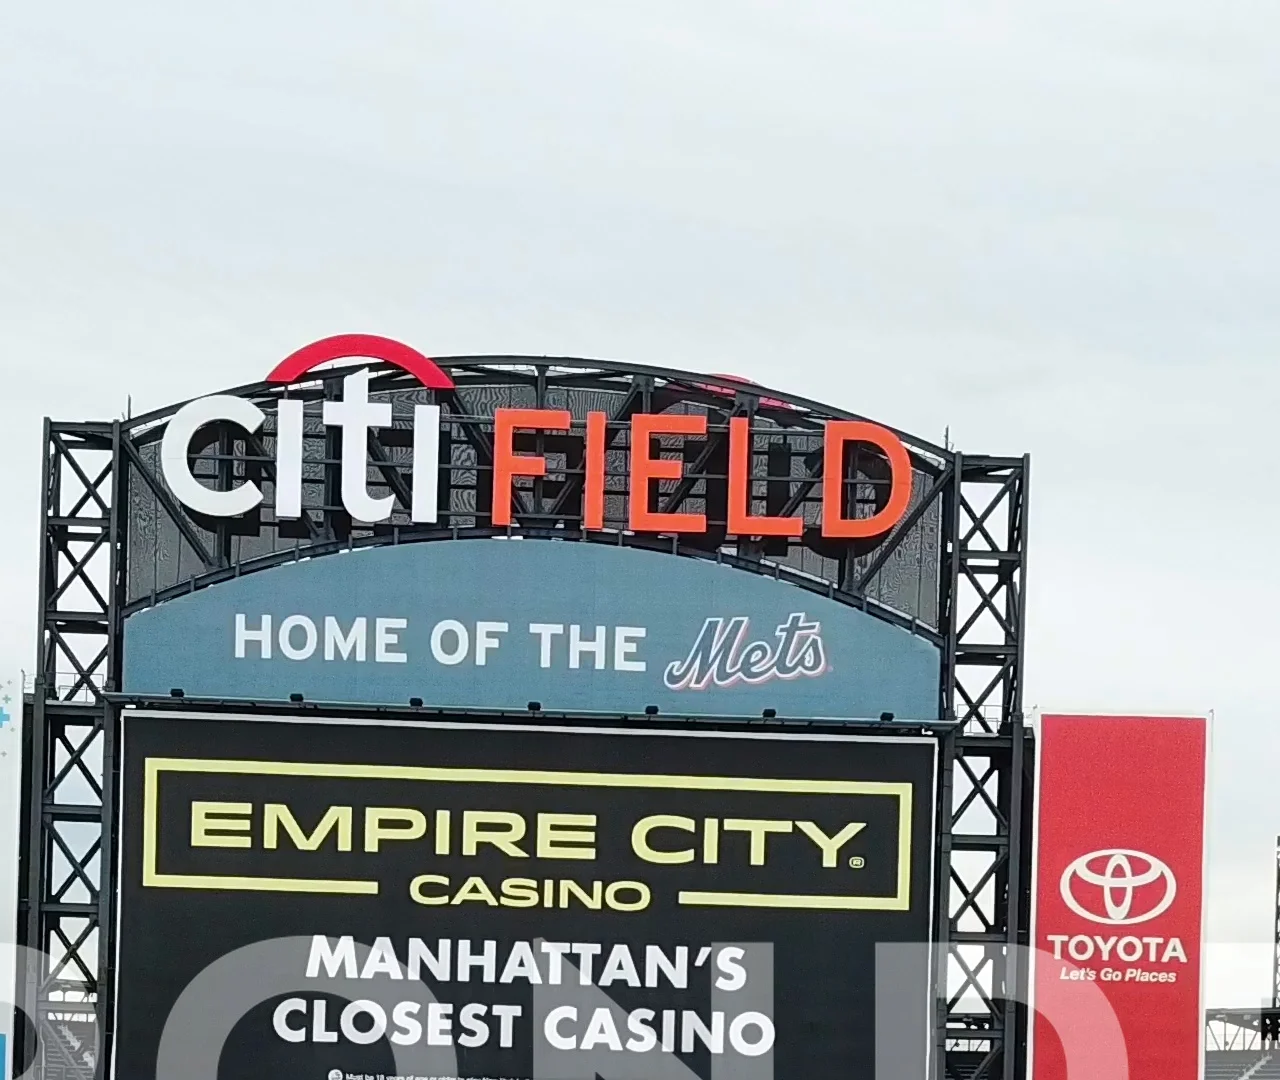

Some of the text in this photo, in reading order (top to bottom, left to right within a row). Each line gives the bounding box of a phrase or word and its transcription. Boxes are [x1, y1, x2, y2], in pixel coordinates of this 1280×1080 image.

[160, 367, 913, 538] citi FIELD
[234, 612, 827, 690] HOME OF THE Mets
[190, 801, 597, 860] EMPIRE
[408, 874, 651, 912] CASINO
[304, 934, 748, 991] MANHATTAN'S
[1047, 934, 1188, 963] TOYOTA
[1060, 966, 1177, 983] Let's Go Places
[272, 998, 776, 1057] CLOSEST CASINO
